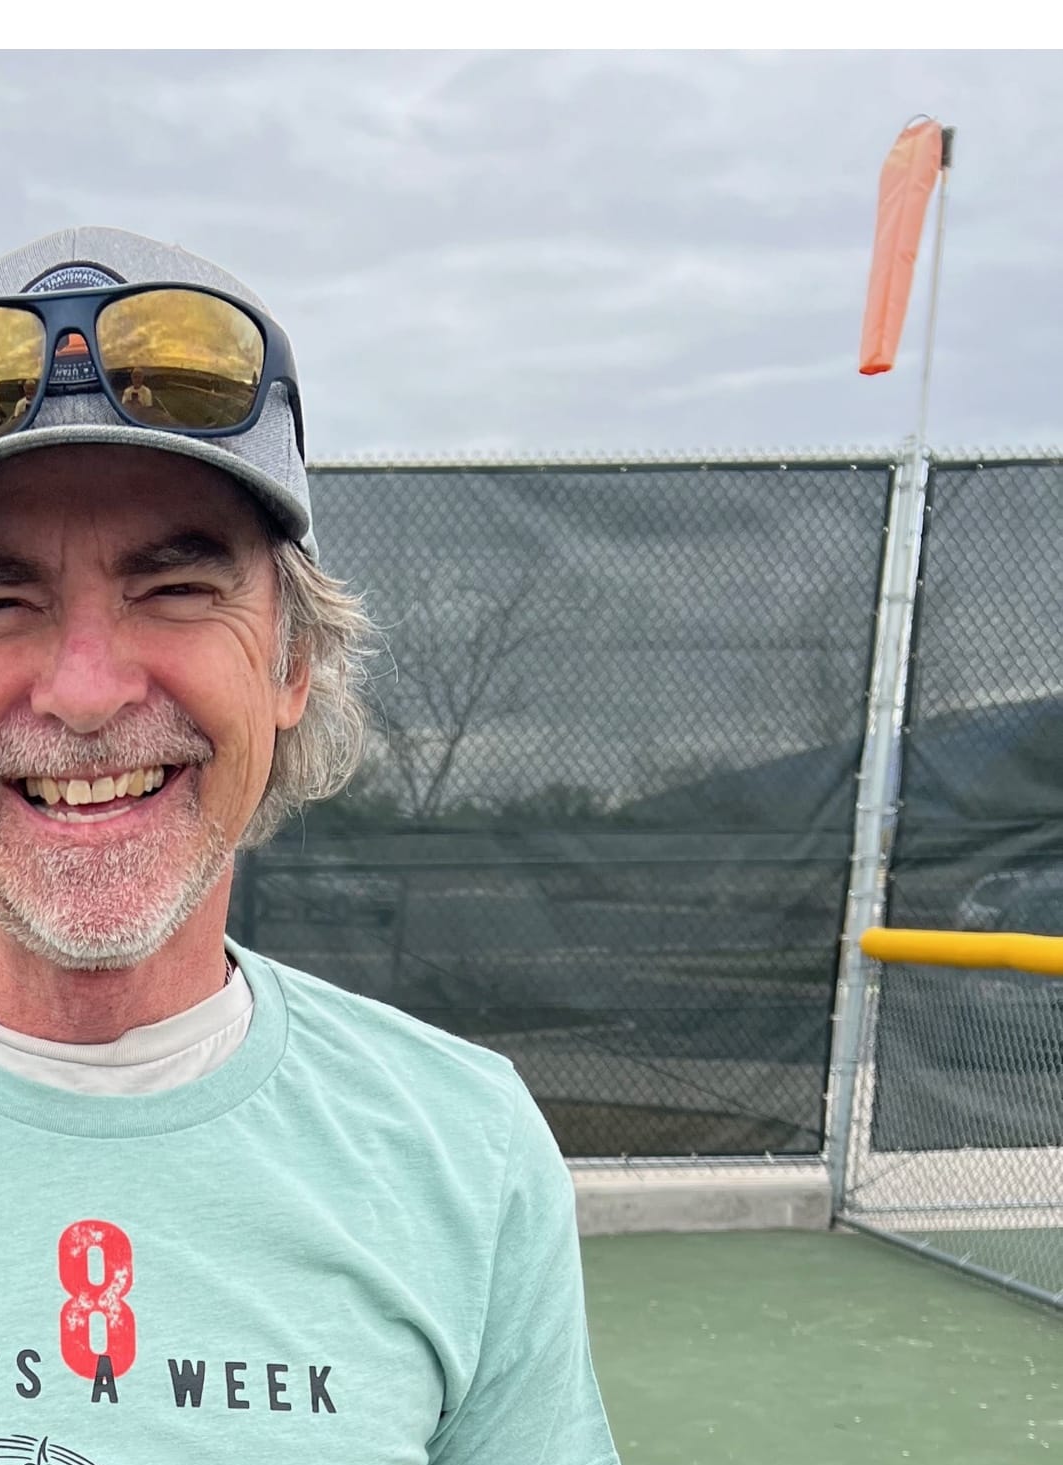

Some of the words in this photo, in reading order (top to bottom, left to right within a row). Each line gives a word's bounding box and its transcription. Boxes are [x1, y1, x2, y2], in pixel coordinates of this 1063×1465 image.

[58, 1218, 137, 1382] 8
[91, 1355, 119, 1404] A
[167, 1358, 338, 1414] WEEK
